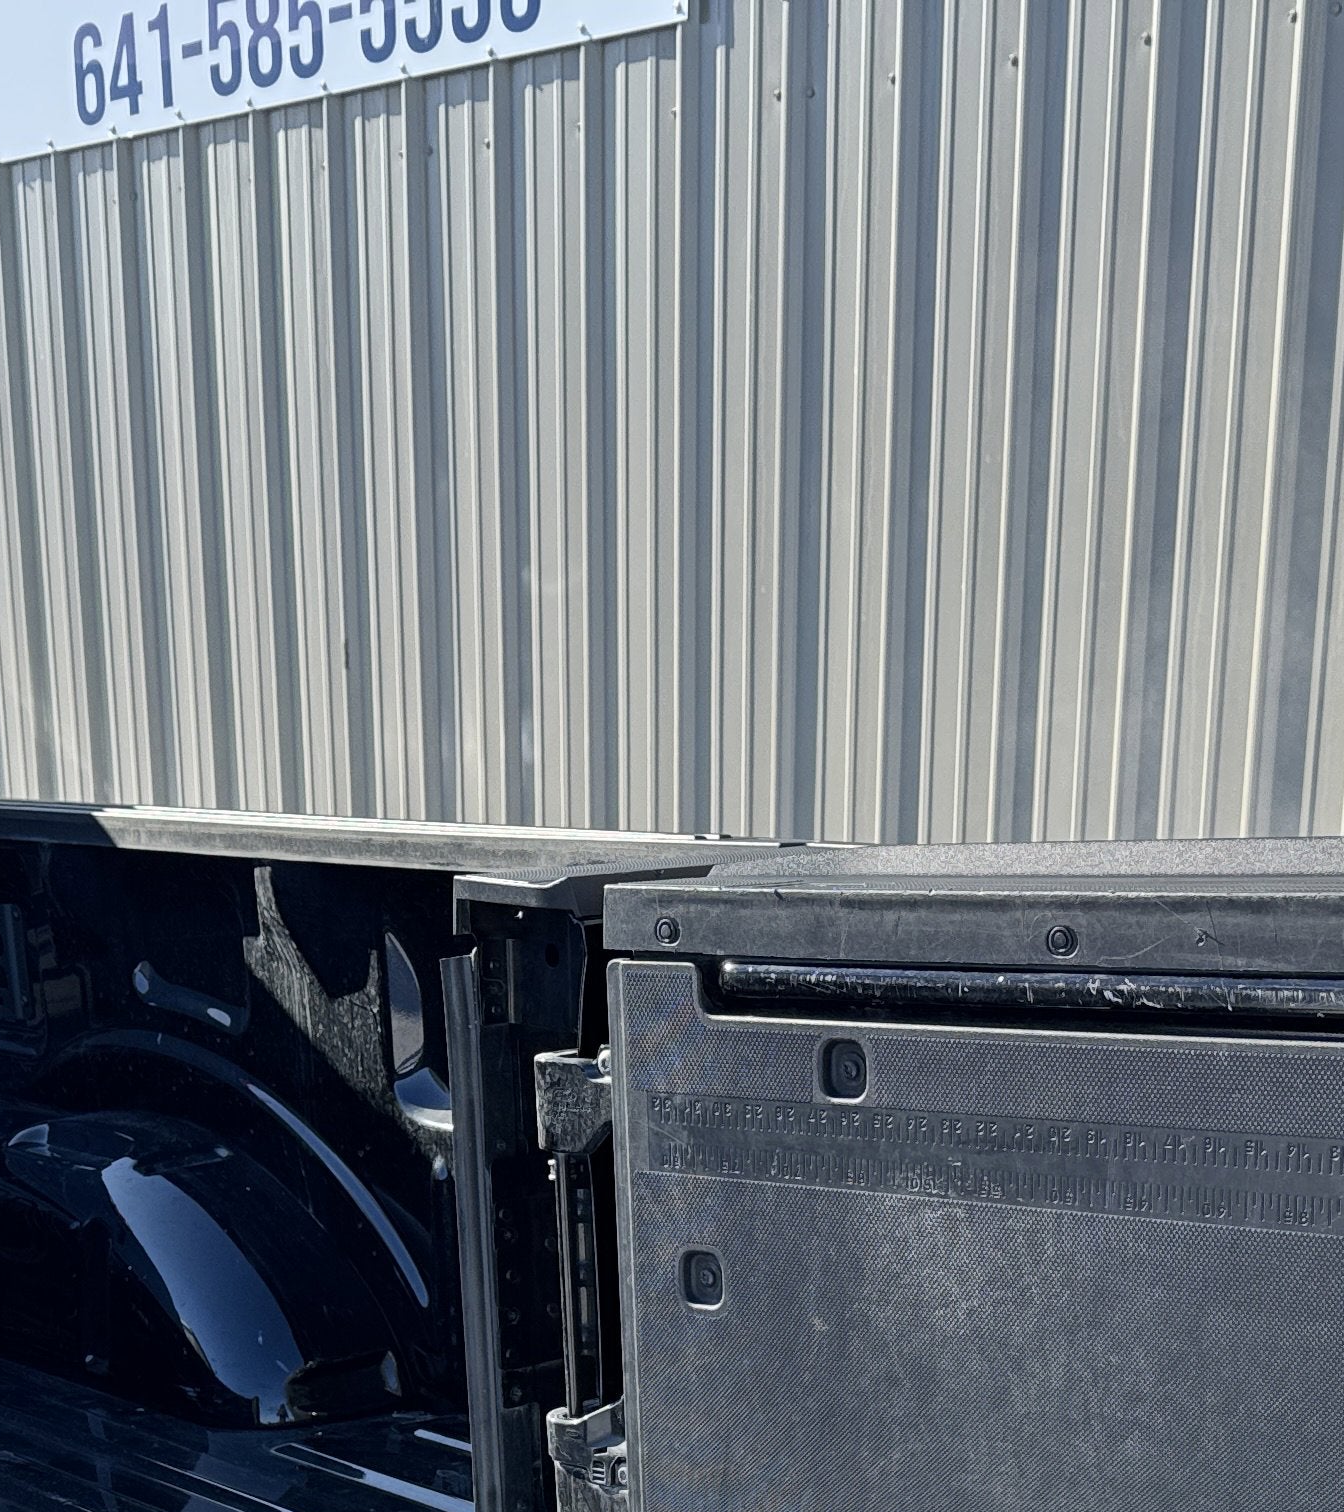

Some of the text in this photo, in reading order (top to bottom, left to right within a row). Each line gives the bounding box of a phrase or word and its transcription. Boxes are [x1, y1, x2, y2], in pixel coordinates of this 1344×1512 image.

[1050, 1126, 1072, 1142] 20
[1087, 1130, 1106, 1145] 19
[1126, 1131, 1146, 1147] 18
[1165, 1134, 1185, 1150] 17
[1205, 1137, 1225, 1153] 16
[1246, 1139, 1267, 1156] 15
[1288, 1143, 1309, 1159] 14
[1126, 1195, 1149, 1211] 45
[1203, 1202, 1227, 1218] 40
[1284, 1209, 1309, 1226] 35
